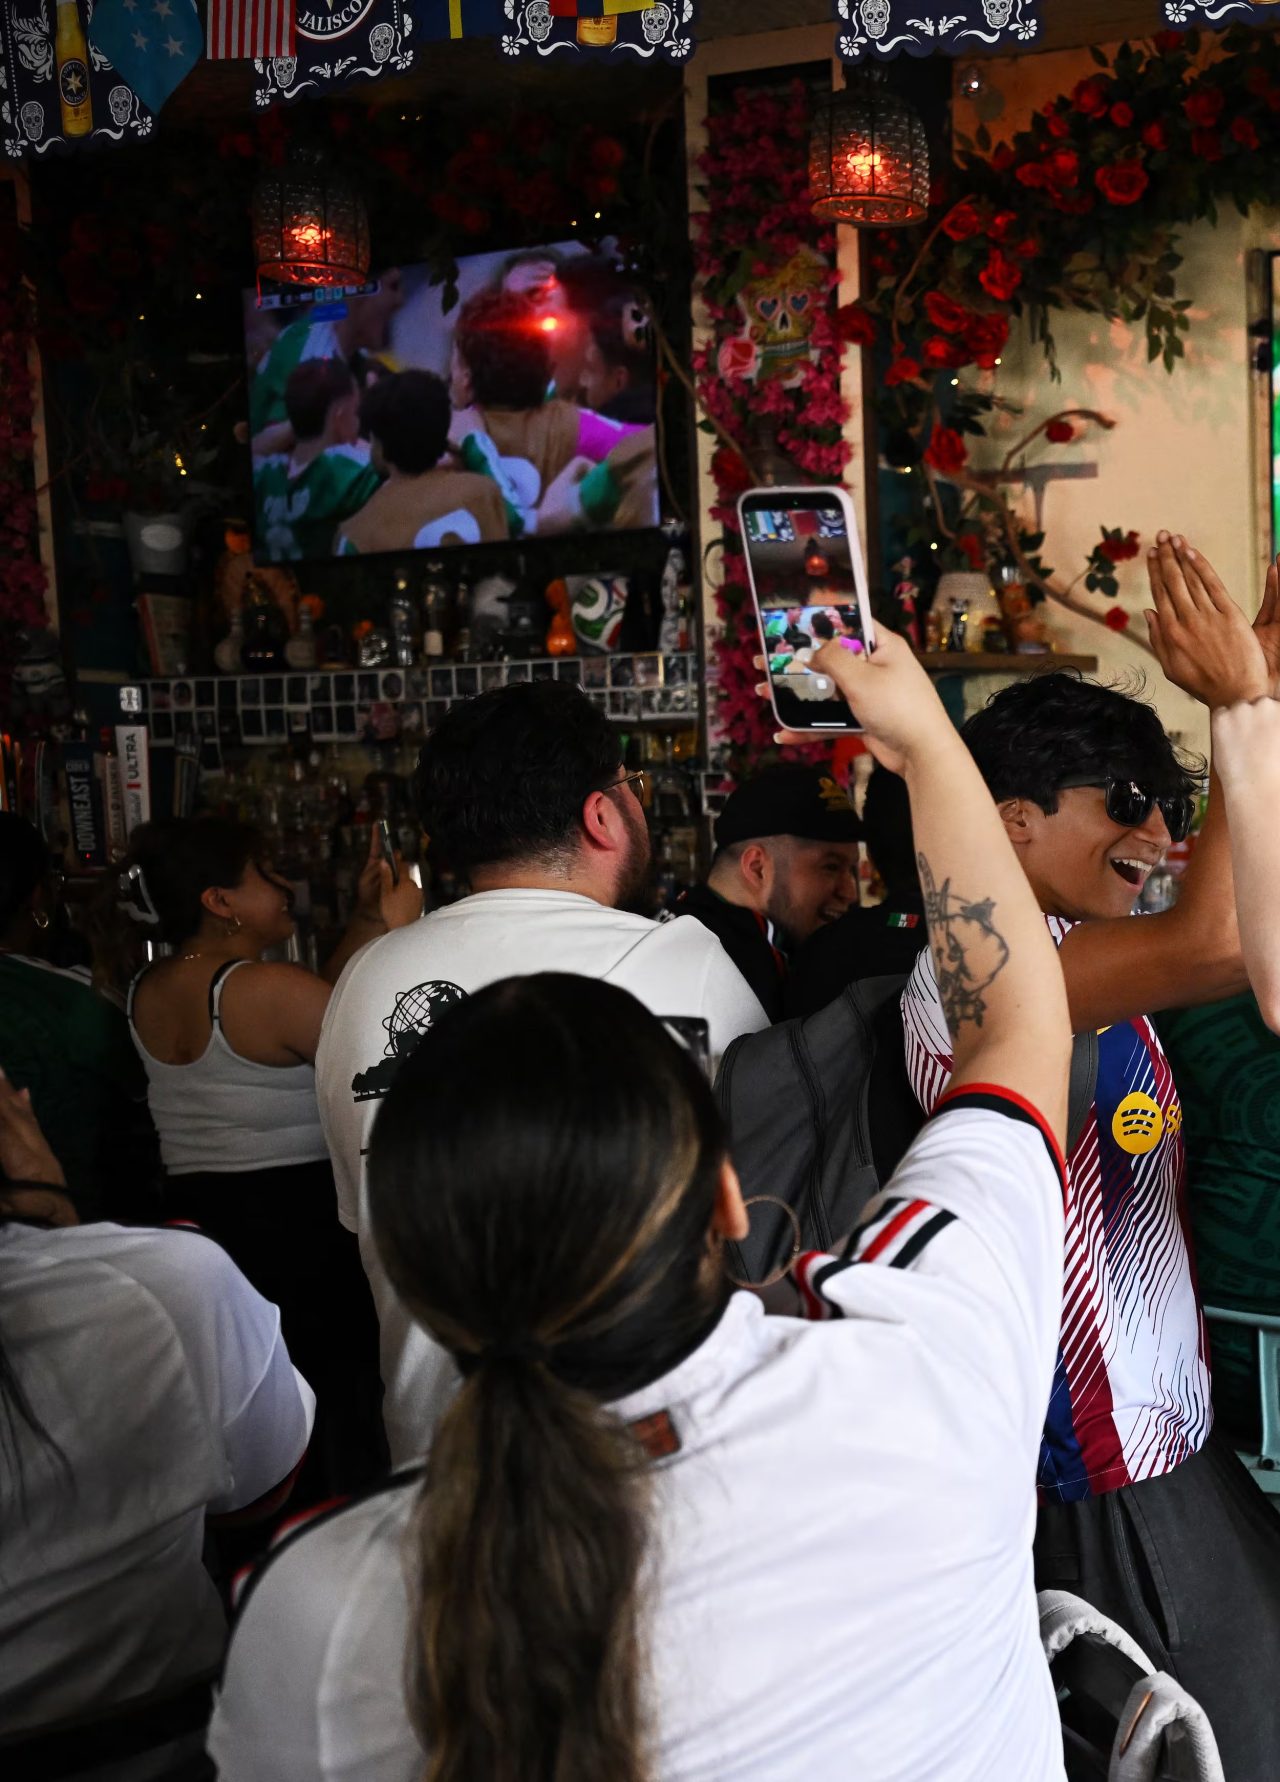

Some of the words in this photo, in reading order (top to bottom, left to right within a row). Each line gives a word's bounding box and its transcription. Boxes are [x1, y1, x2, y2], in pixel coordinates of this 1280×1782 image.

[298, 0, 362, 32] JALISCO
[124, 733, 140, 780] ULTRA
[69, 775, 96, 852] DOWNEAST
